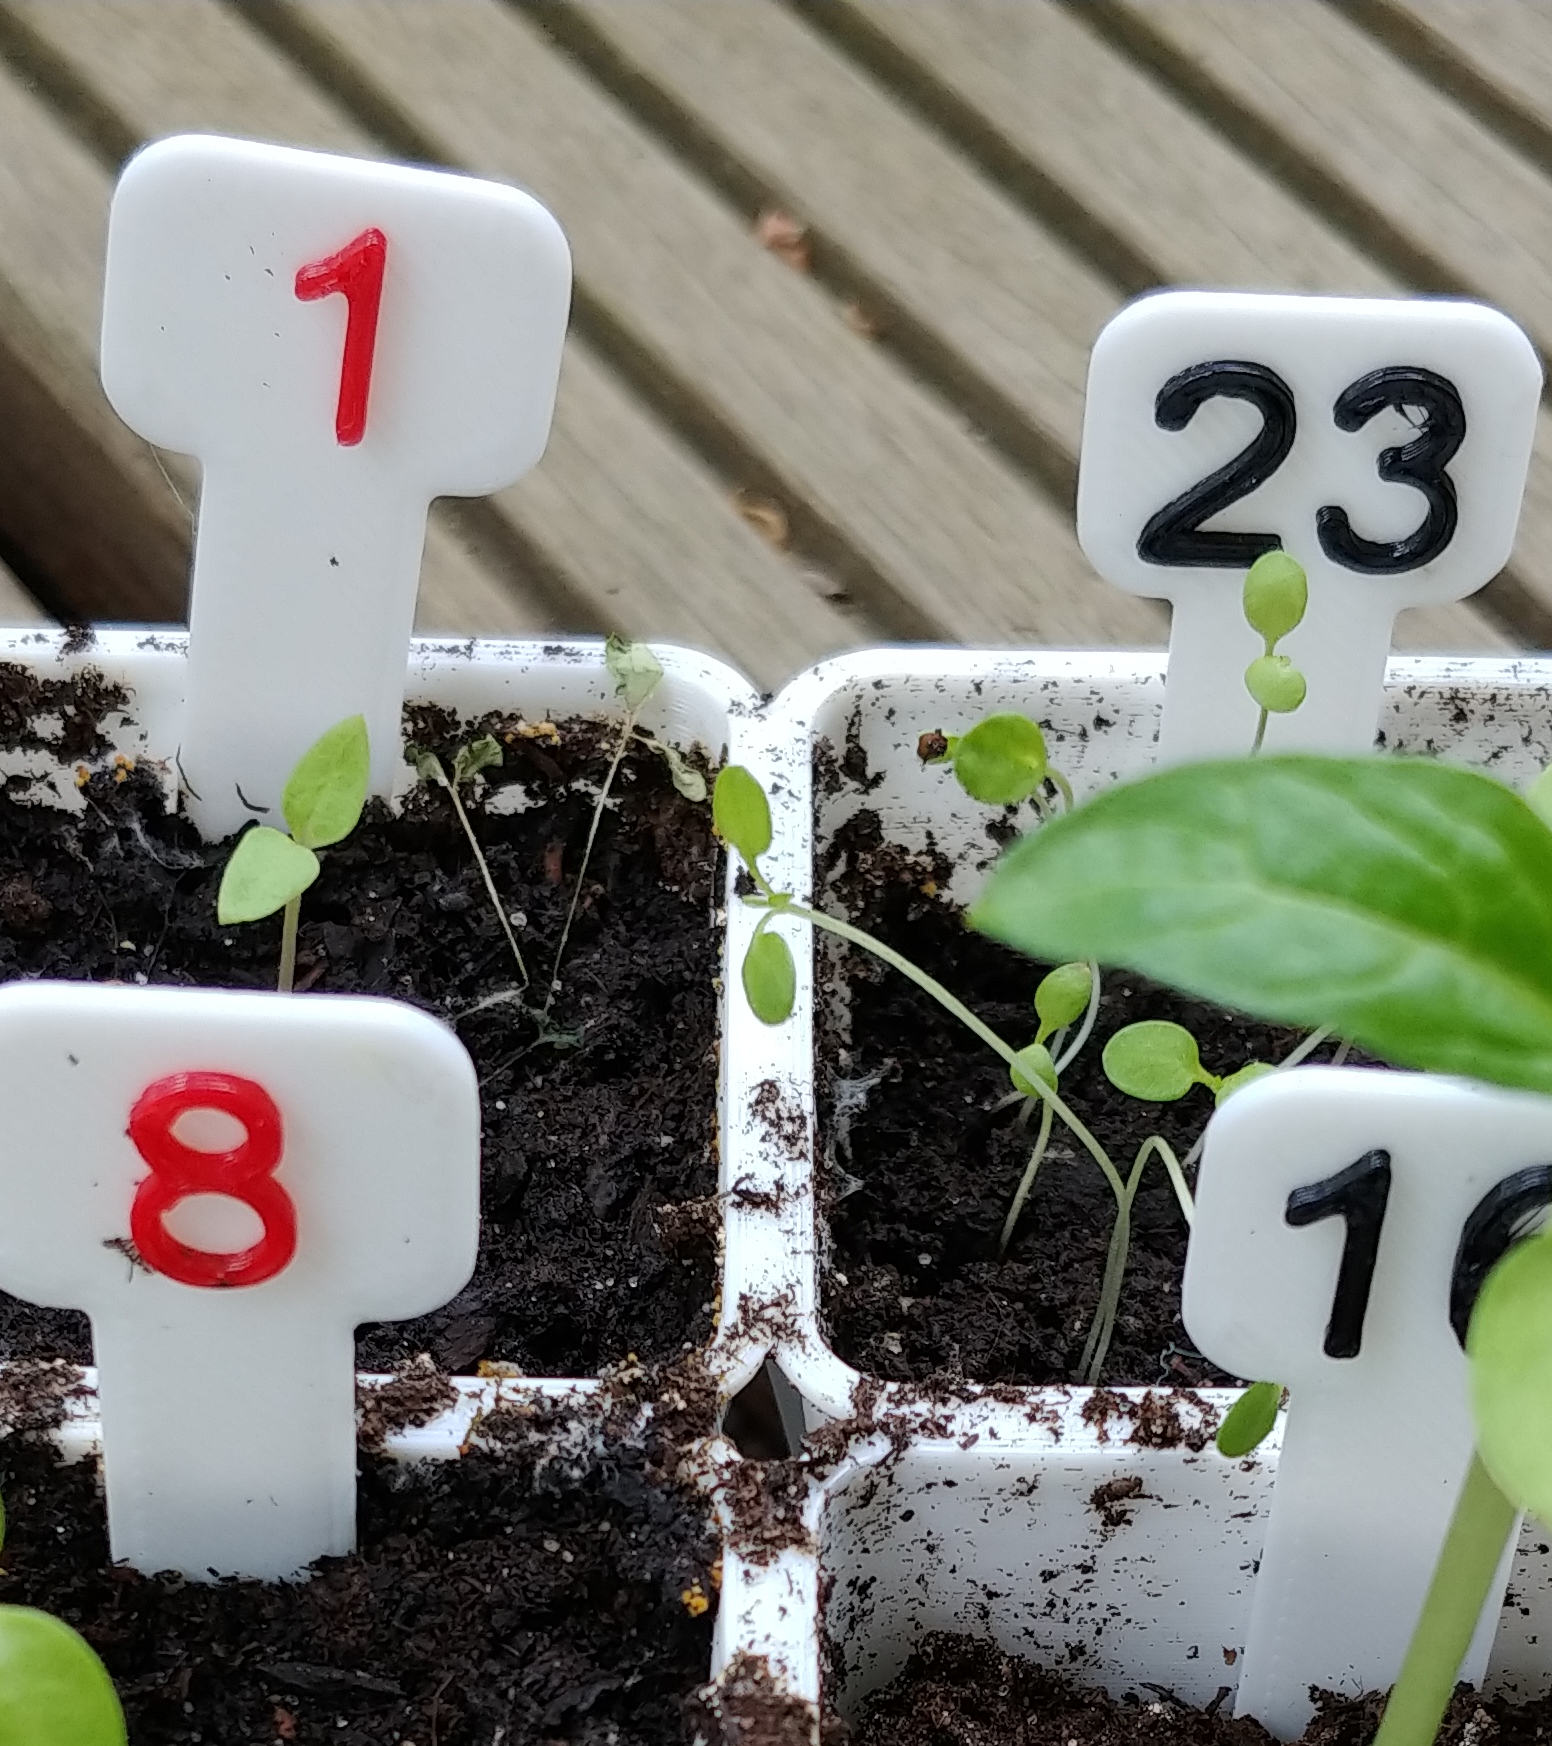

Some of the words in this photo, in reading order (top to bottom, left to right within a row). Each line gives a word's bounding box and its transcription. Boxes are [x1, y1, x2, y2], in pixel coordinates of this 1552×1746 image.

[294, 227, 387, 447] 1
[1136, 359, 1467, 575] 23
[129, 1070, 298, 1288] 8
